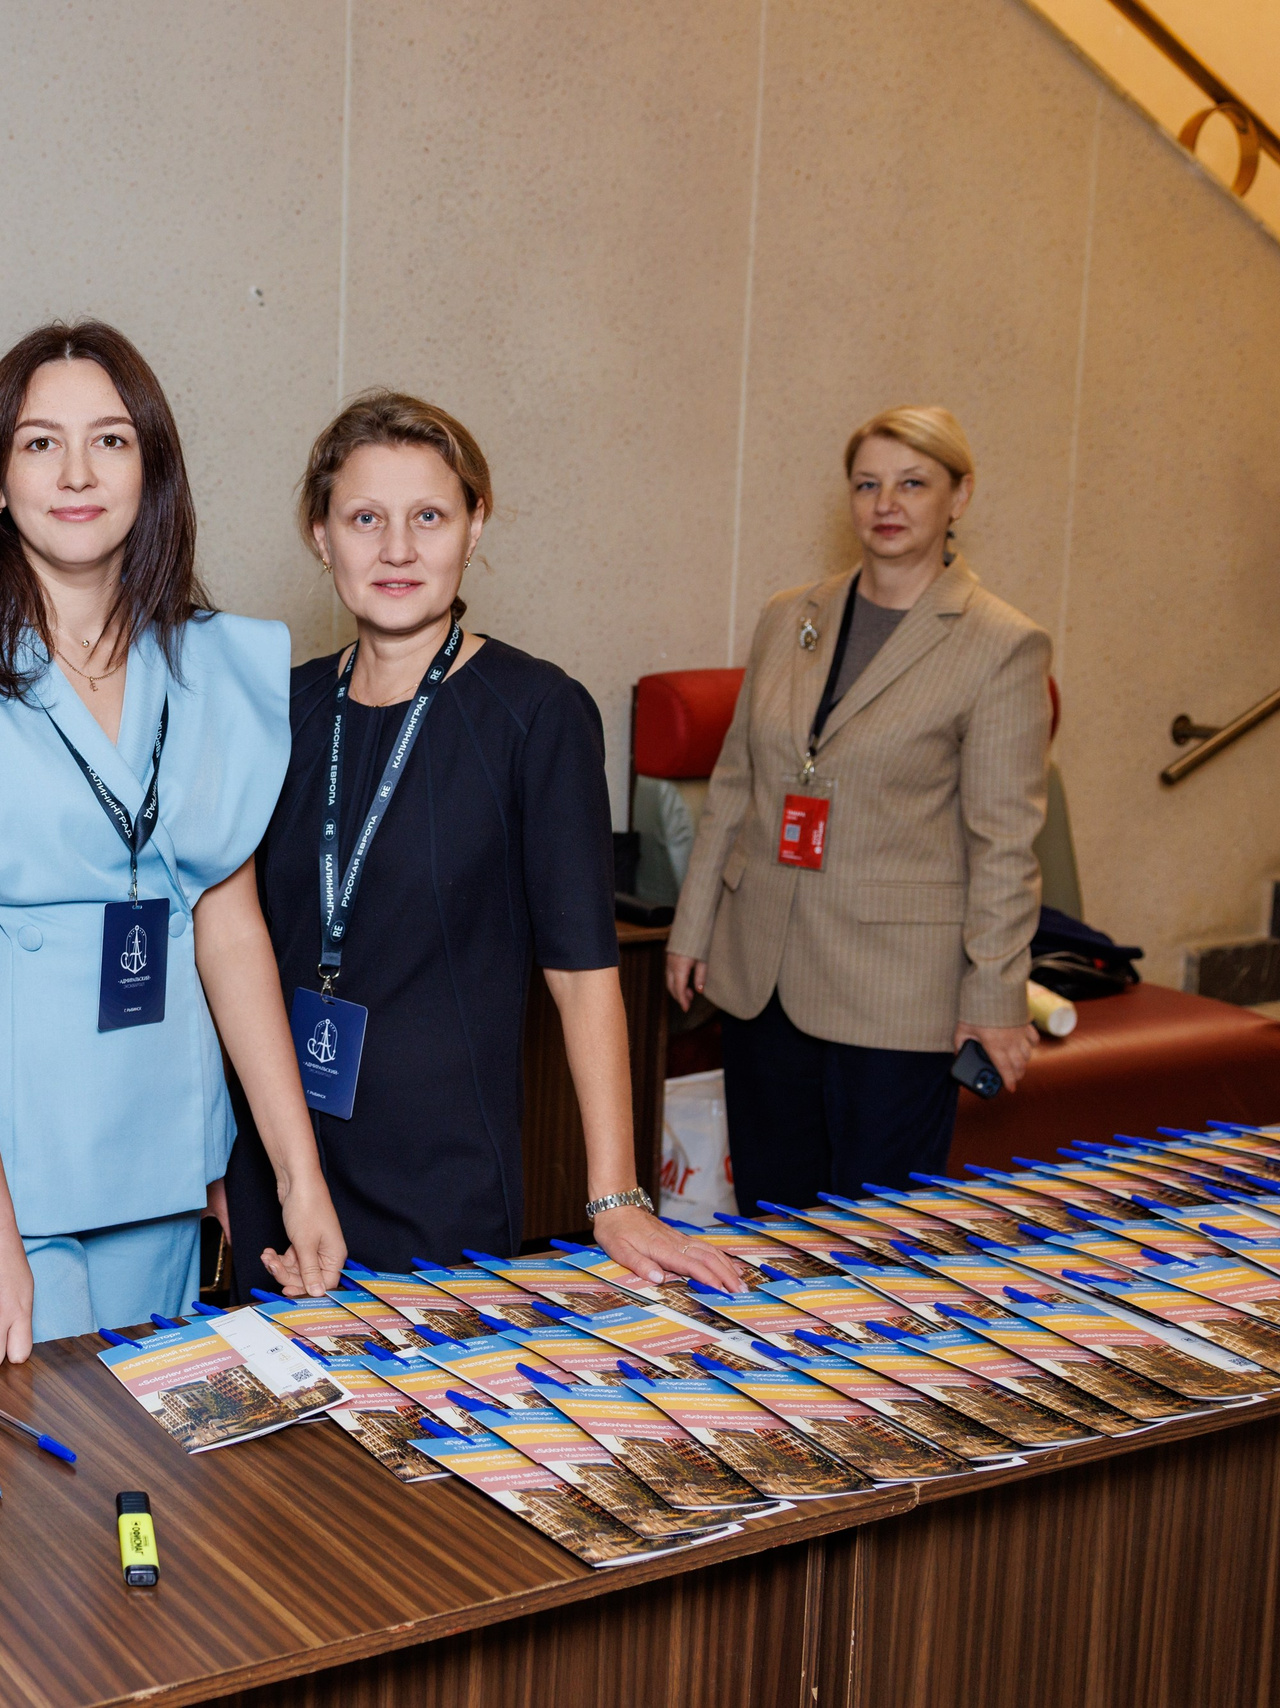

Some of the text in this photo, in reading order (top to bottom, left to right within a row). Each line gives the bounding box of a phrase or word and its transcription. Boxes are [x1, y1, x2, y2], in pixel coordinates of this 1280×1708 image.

[430, 669, 442, 680] RE
[338, 686, 345, 698] RE
[392, 695, 429, 769] КАЛИНИНГРАД
[328, 715, 341, 806] РУССКАЯ ЕВРОПА
[381, 785, 391, 797] RE
[325, 824, 333, 835] RE
[341, 815, 378, 907] РУССКАЯ ЕВРОПА
[333, 925, 343, 937] RE
[641, 1333, 700, 1349] «Soloviev architects»
[122, 1339, 217, 1371] «Авторский проект»
[166, 1353, 193, 1364] Тюмень
[138, 1355, 232, 1387] «Soloviev architects»
[168, 1366, 220, 1384] Калининград
[588, 1421, 681, 1430] «Soloviev architects»
[533, 1446, 576, 1455] «Soloviev
[450, 1454, 502, 1464] «Авторский
[481, 1473, 522, 1483] «Soloviev
